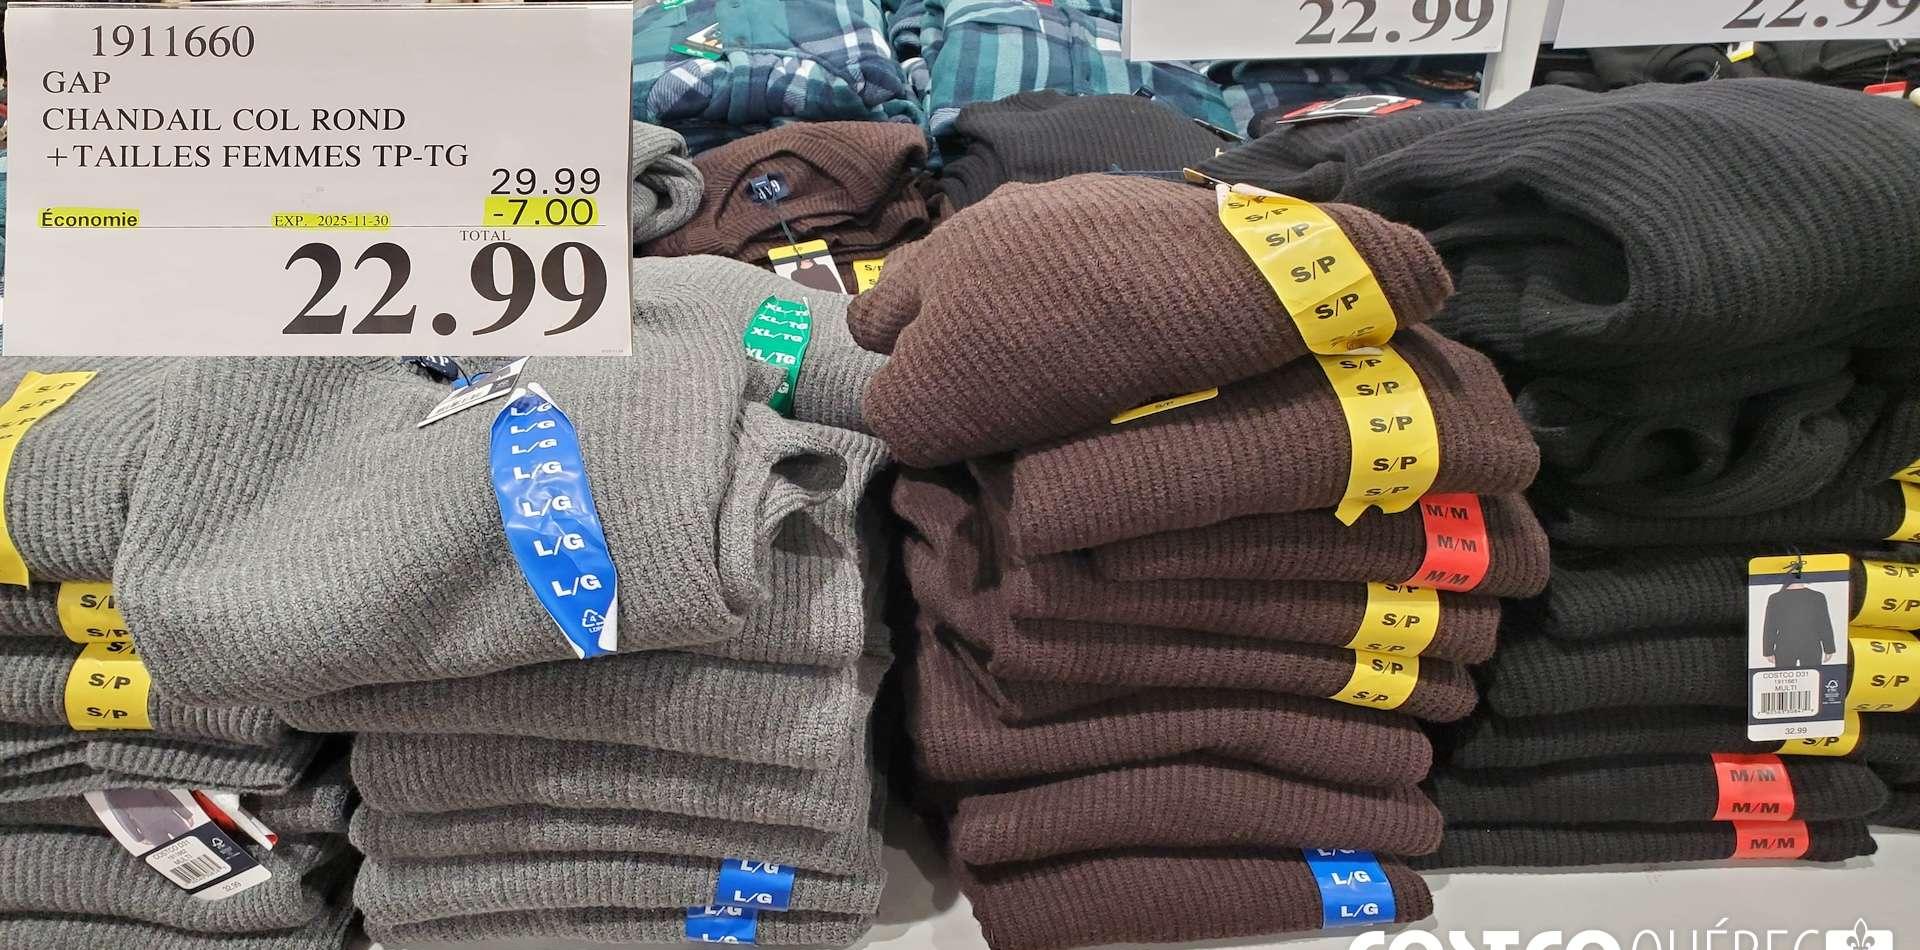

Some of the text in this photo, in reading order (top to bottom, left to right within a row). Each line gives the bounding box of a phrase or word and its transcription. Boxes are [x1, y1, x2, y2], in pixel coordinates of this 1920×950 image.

[1295, 0, 1495, 45] 22.99
[92, 24, 255, 58] 1911660
[42, 70, 111, 94] GAP
[42, 107, 406, 131] CHANDAIL COL ROND
[46, 144, 469, 168] +TAILLES FEMMES TP-TG
[490, 168, 601, 195] 29.99
[41, 209, 389, 229] Économie EXP. 2025-11-30
[493, 198, 594, 226] -7.00
[1245, 207, 1289, 223] S/P
[459, 230, 511, 242] TOTAL
[1265, 223, 1310, 247] S/P
[1290, 255, 1336, 283] S/P
[281, 241, 608, 337] 22.99
[1314, 293, 1359, 320] S/P
[750, 327, 803, 343] XL/TG
[1339, 359, 1382, 369] S/P
[1356, 381, 1400, 396] S/P
[510, 402, 552, 416] L/G
[510, 420, 556, 434] L/G
[1369, 416, 1413, 433] S/P
[511, 438, 558, 454] L/G
[513, 461, 563, 480] L/G
[1373, 456, 1418, 472] S/P
[1364, 486, 1410, 497] S/P
[522, 495, 572, 517] L/G
[1426, 504, 1469, 520] M/M
[533, 533, 585, 557] L/G
[1437, 534, 1477, 553] M/M
[552, 574, 602, 597] L/G
[1424, 570, 1470, 585] M/M
[1881, 598, 1920, 612] S/P
[1381, 613, 1420, 629] S/P
[86, 628, 129, 639] S/P
[1870, 641, 1908, 654] S/P
[1371, 658, 1404, 675] S/P
[88, 673, 131, 689] S/P
[1870, 675, 1910, 688] S/P
[1352, 691, 1389, 702] S/P
[86, 707, 129, 719] S/P
[1785, 727, 1808, 735] 32.99
[1729, 768, 1776, 783] M/M
[1731, 802, 1780, 814] M/M
[1749, 836, 1795, 849] M/M
[740, 860, 780, 874] L/G
[1331, 870, 1372, 885] L/G
[733, 890, 773, 905] L/G
[1341, 903, 1379, 917] L/G
